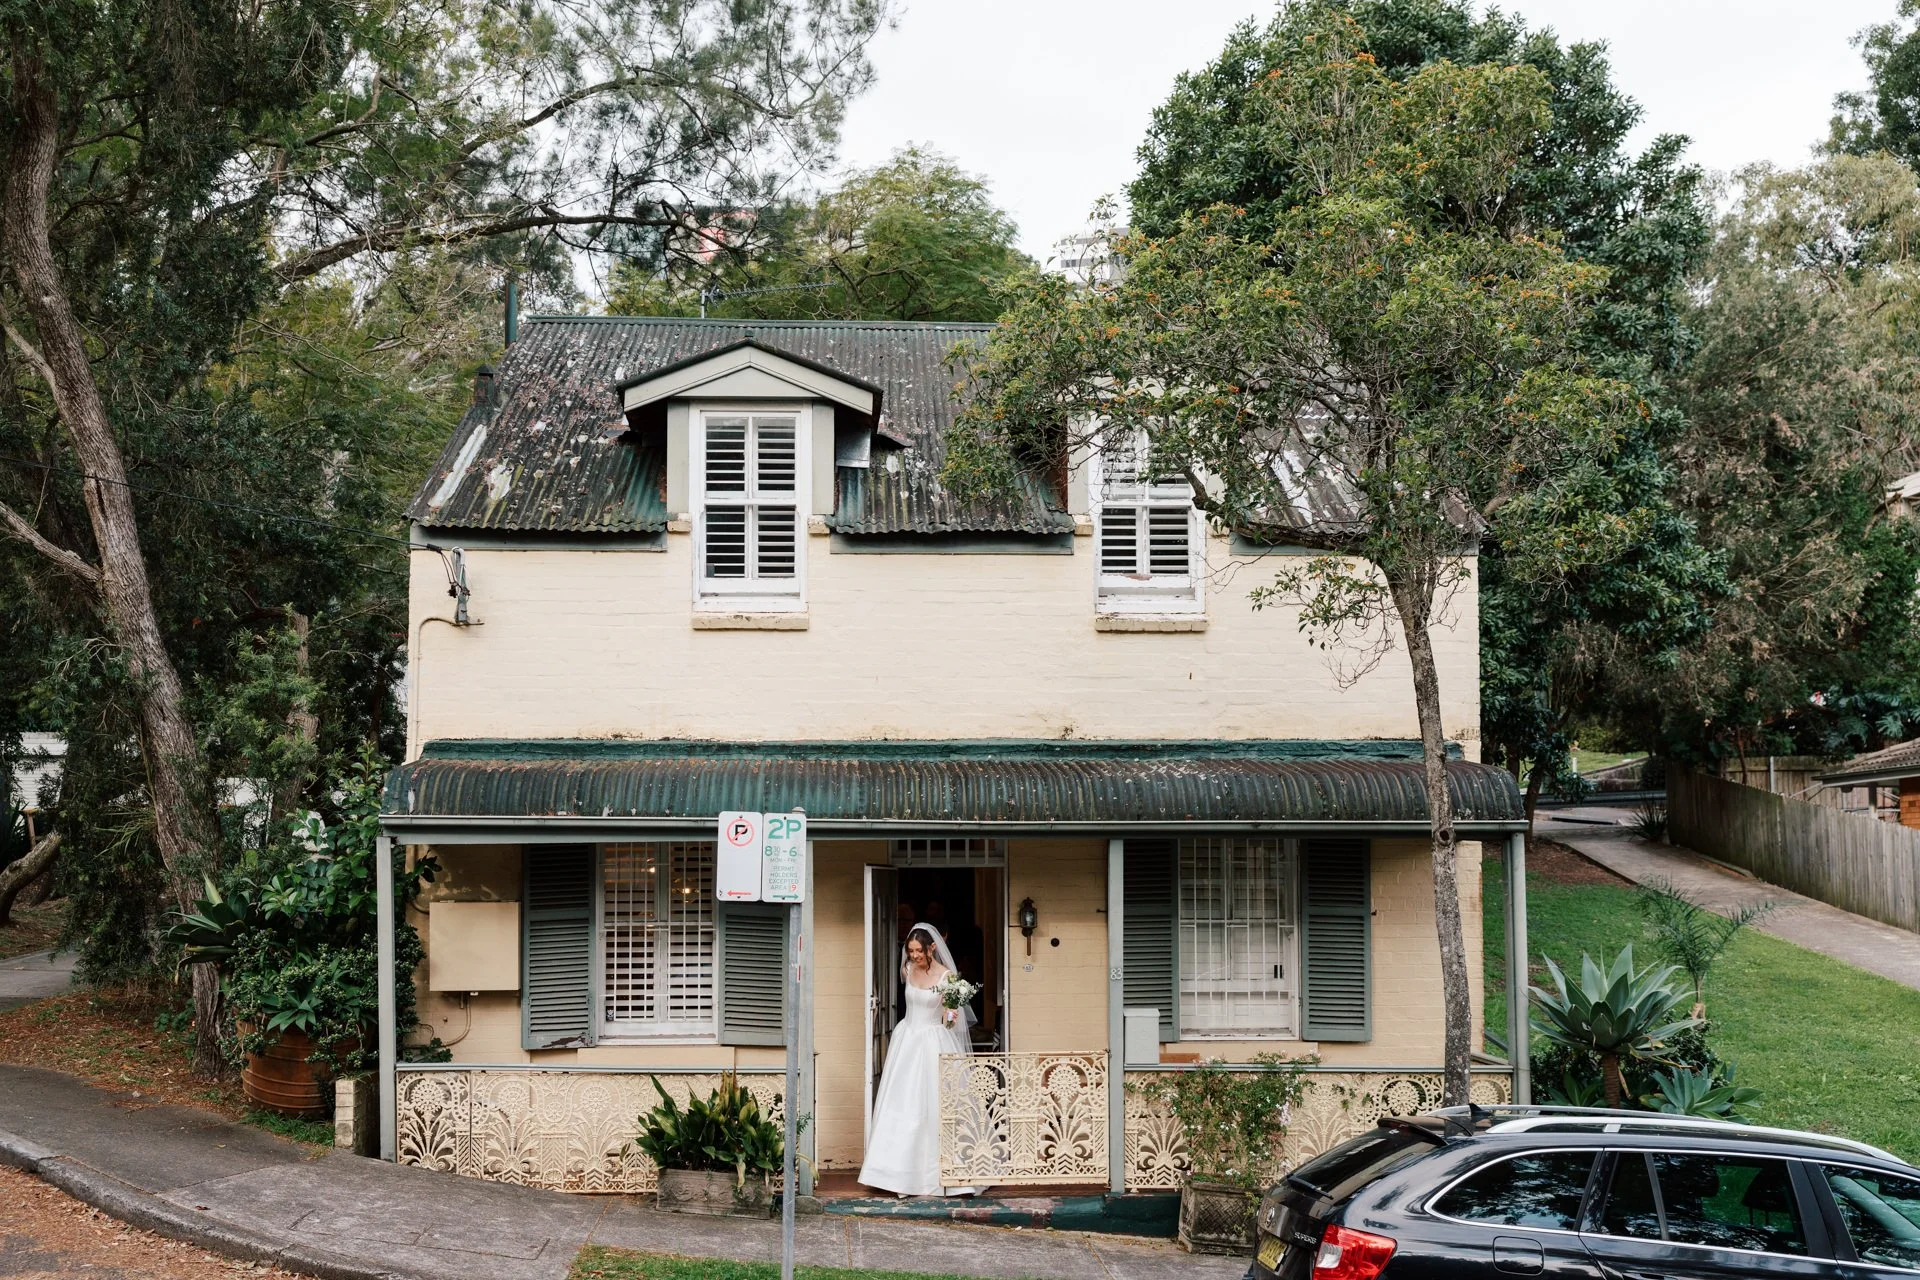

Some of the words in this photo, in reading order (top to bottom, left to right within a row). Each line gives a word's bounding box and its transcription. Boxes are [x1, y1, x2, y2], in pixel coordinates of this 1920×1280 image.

[735, 824, 748, 841] P
[768, 818, 802, 839] 2P
[1110, 967, 1122, 980] 83
